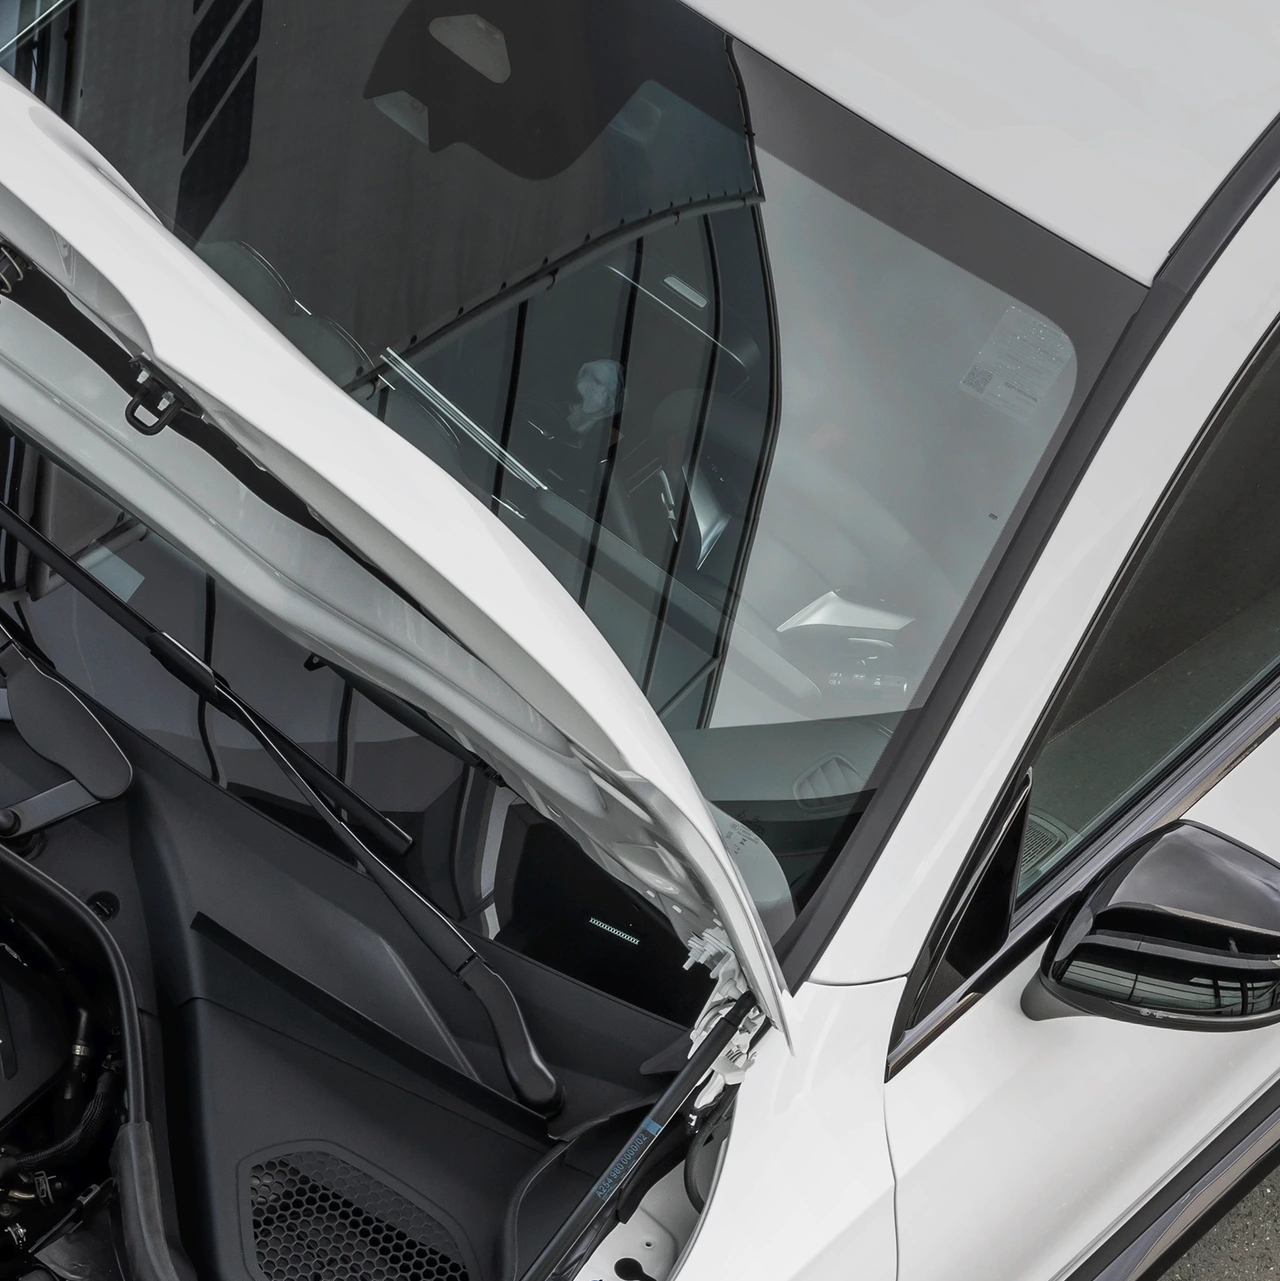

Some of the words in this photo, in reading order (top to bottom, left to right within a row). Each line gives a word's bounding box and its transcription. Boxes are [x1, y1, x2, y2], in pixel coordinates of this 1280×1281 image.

[596, 1178, 613, 1198] A254
[611, 1163, 624, 1178] 980
[621, 1134, 648, 1165] 0000/02
